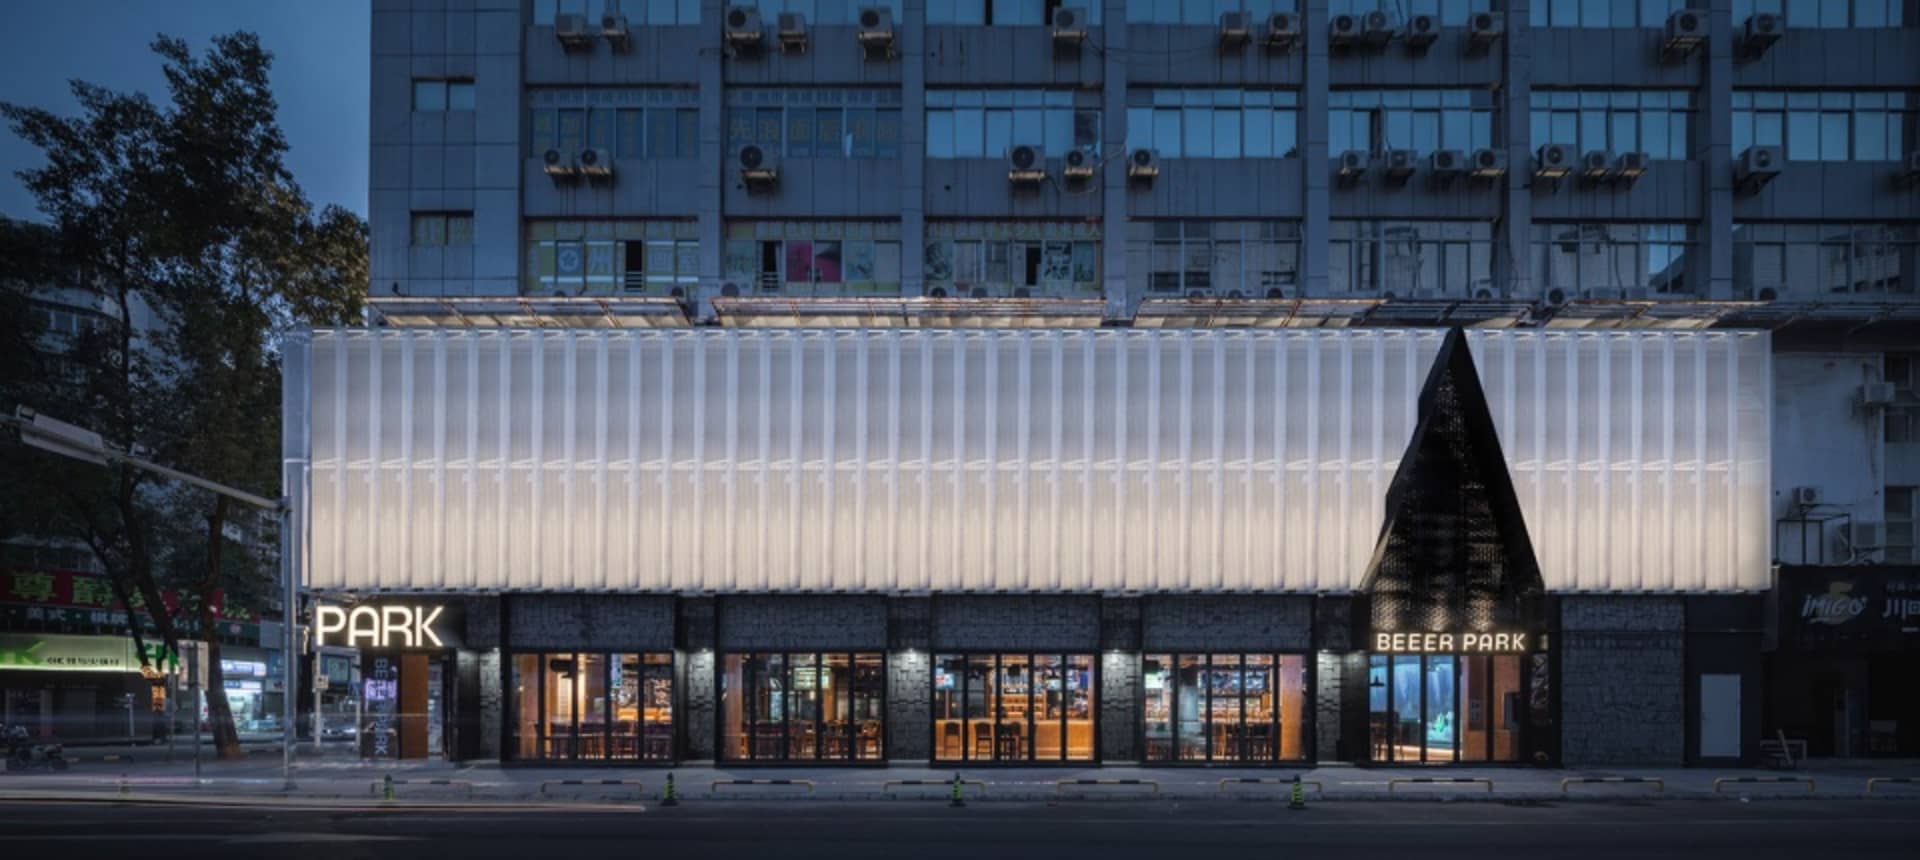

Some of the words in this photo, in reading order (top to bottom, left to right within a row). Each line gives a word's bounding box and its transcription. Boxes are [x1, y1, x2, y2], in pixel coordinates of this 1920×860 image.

[315, 605, 444, 647] PARK
[1376, 632, 1454, 652] BEEER
[1463, 632, 1526, 652] PARK
